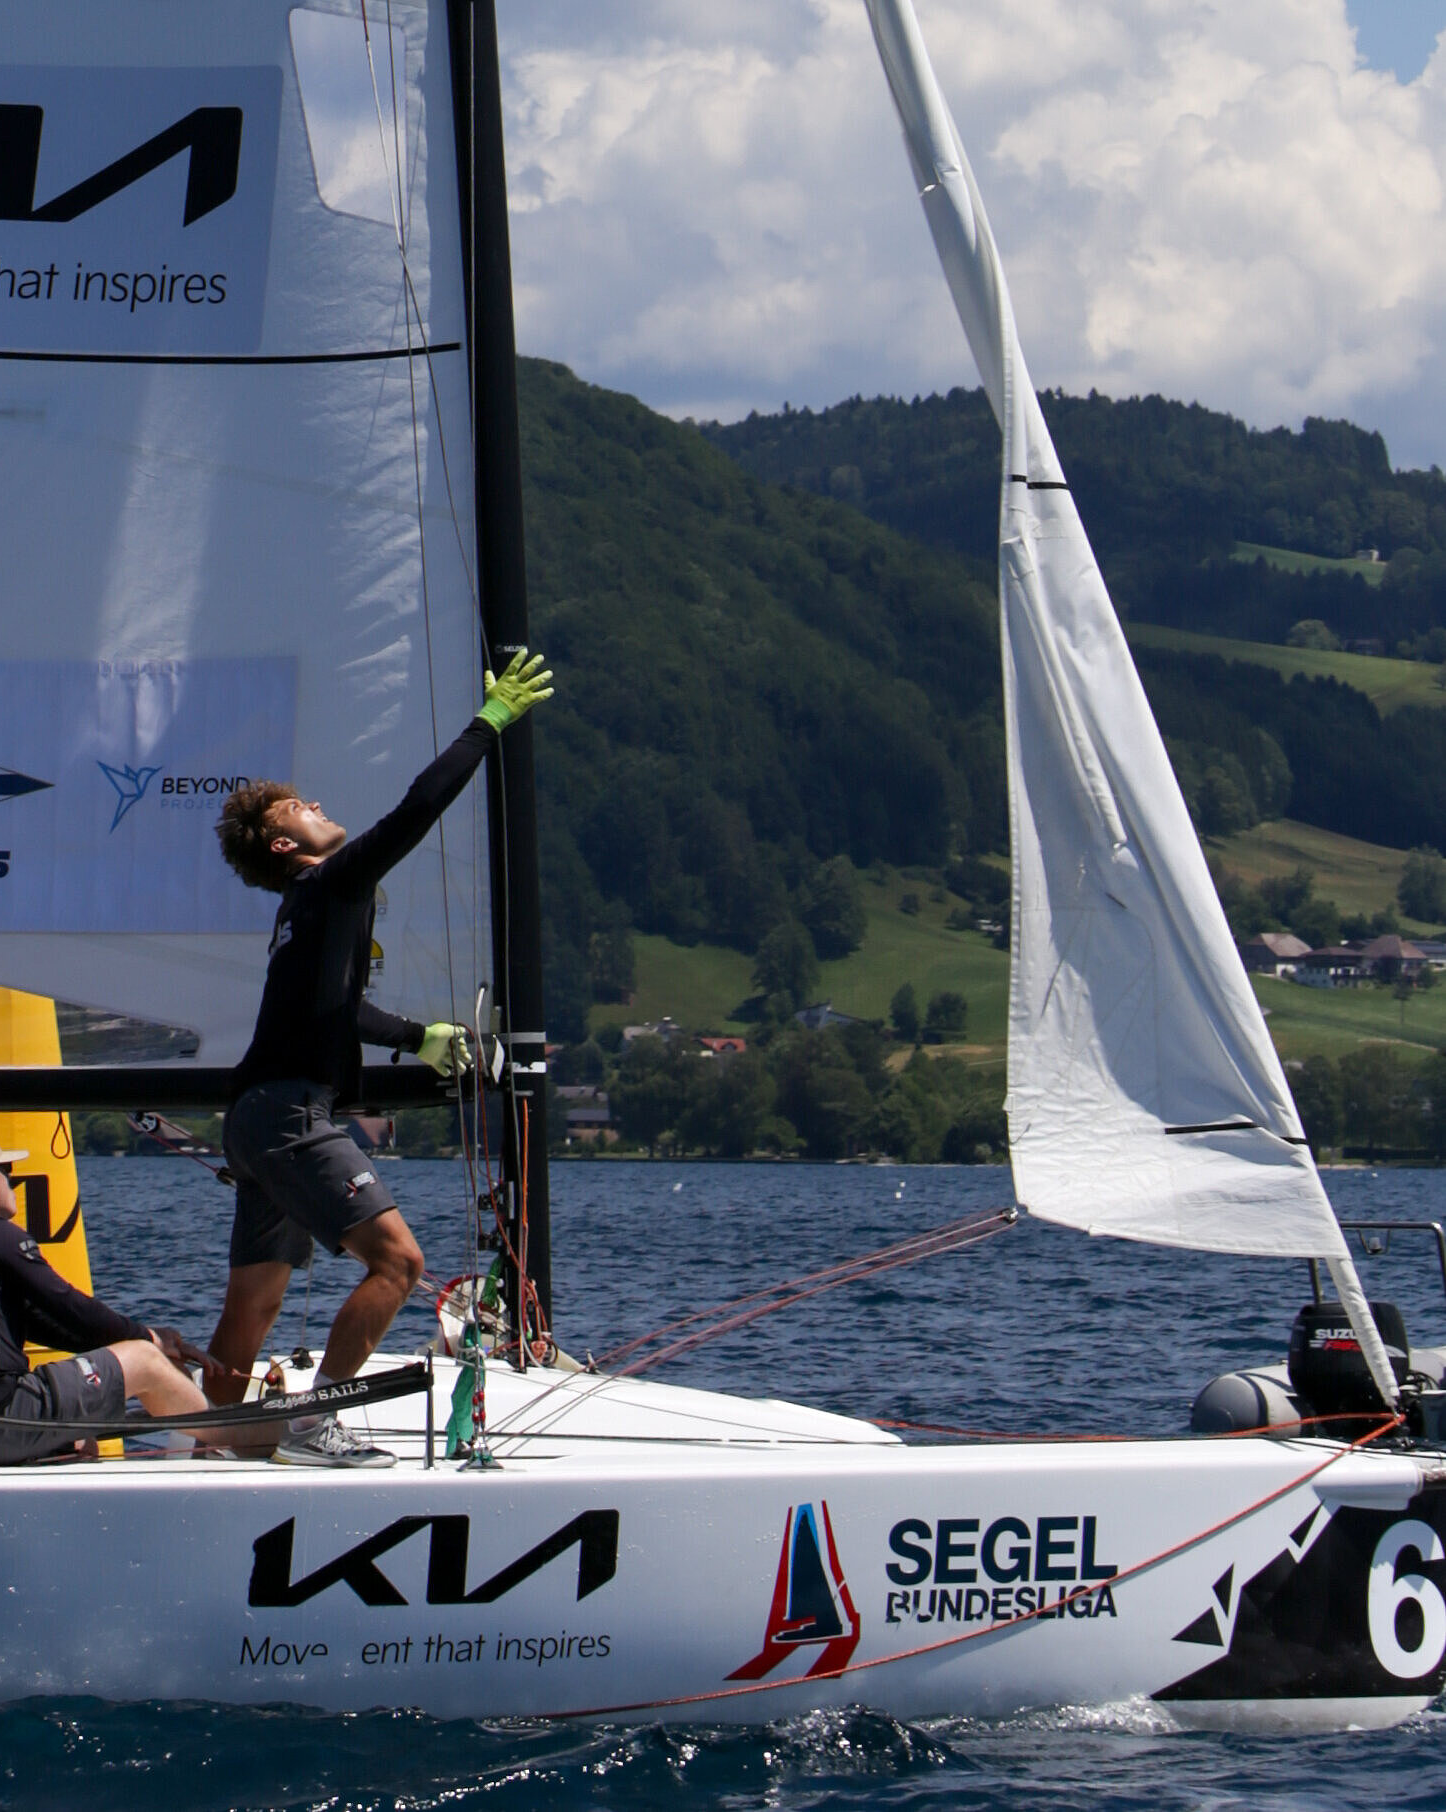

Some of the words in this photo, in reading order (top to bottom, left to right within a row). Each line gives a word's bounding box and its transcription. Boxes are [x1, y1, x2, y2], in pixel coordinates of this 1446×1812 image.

[72, 263, 227, 313] inspires
[161, 776, 251, 794] BEYOND
[1314, 1328, 1358, 1340] SUZU
[317, 1380, 369, 1401] SAILS
[247, 1508, 620, 1608] KIA
[885, 1515, 1118, 1586] SEGEL
[885, 1584, 1118, 1624] BUNDESLIGA
[1367, 1518, 1446, 1680] 6
[238, 1635, 413, 1665] Moveent
[423, 1631, 488, 1664] that
[495, 1630, 611, 1667] inspires
